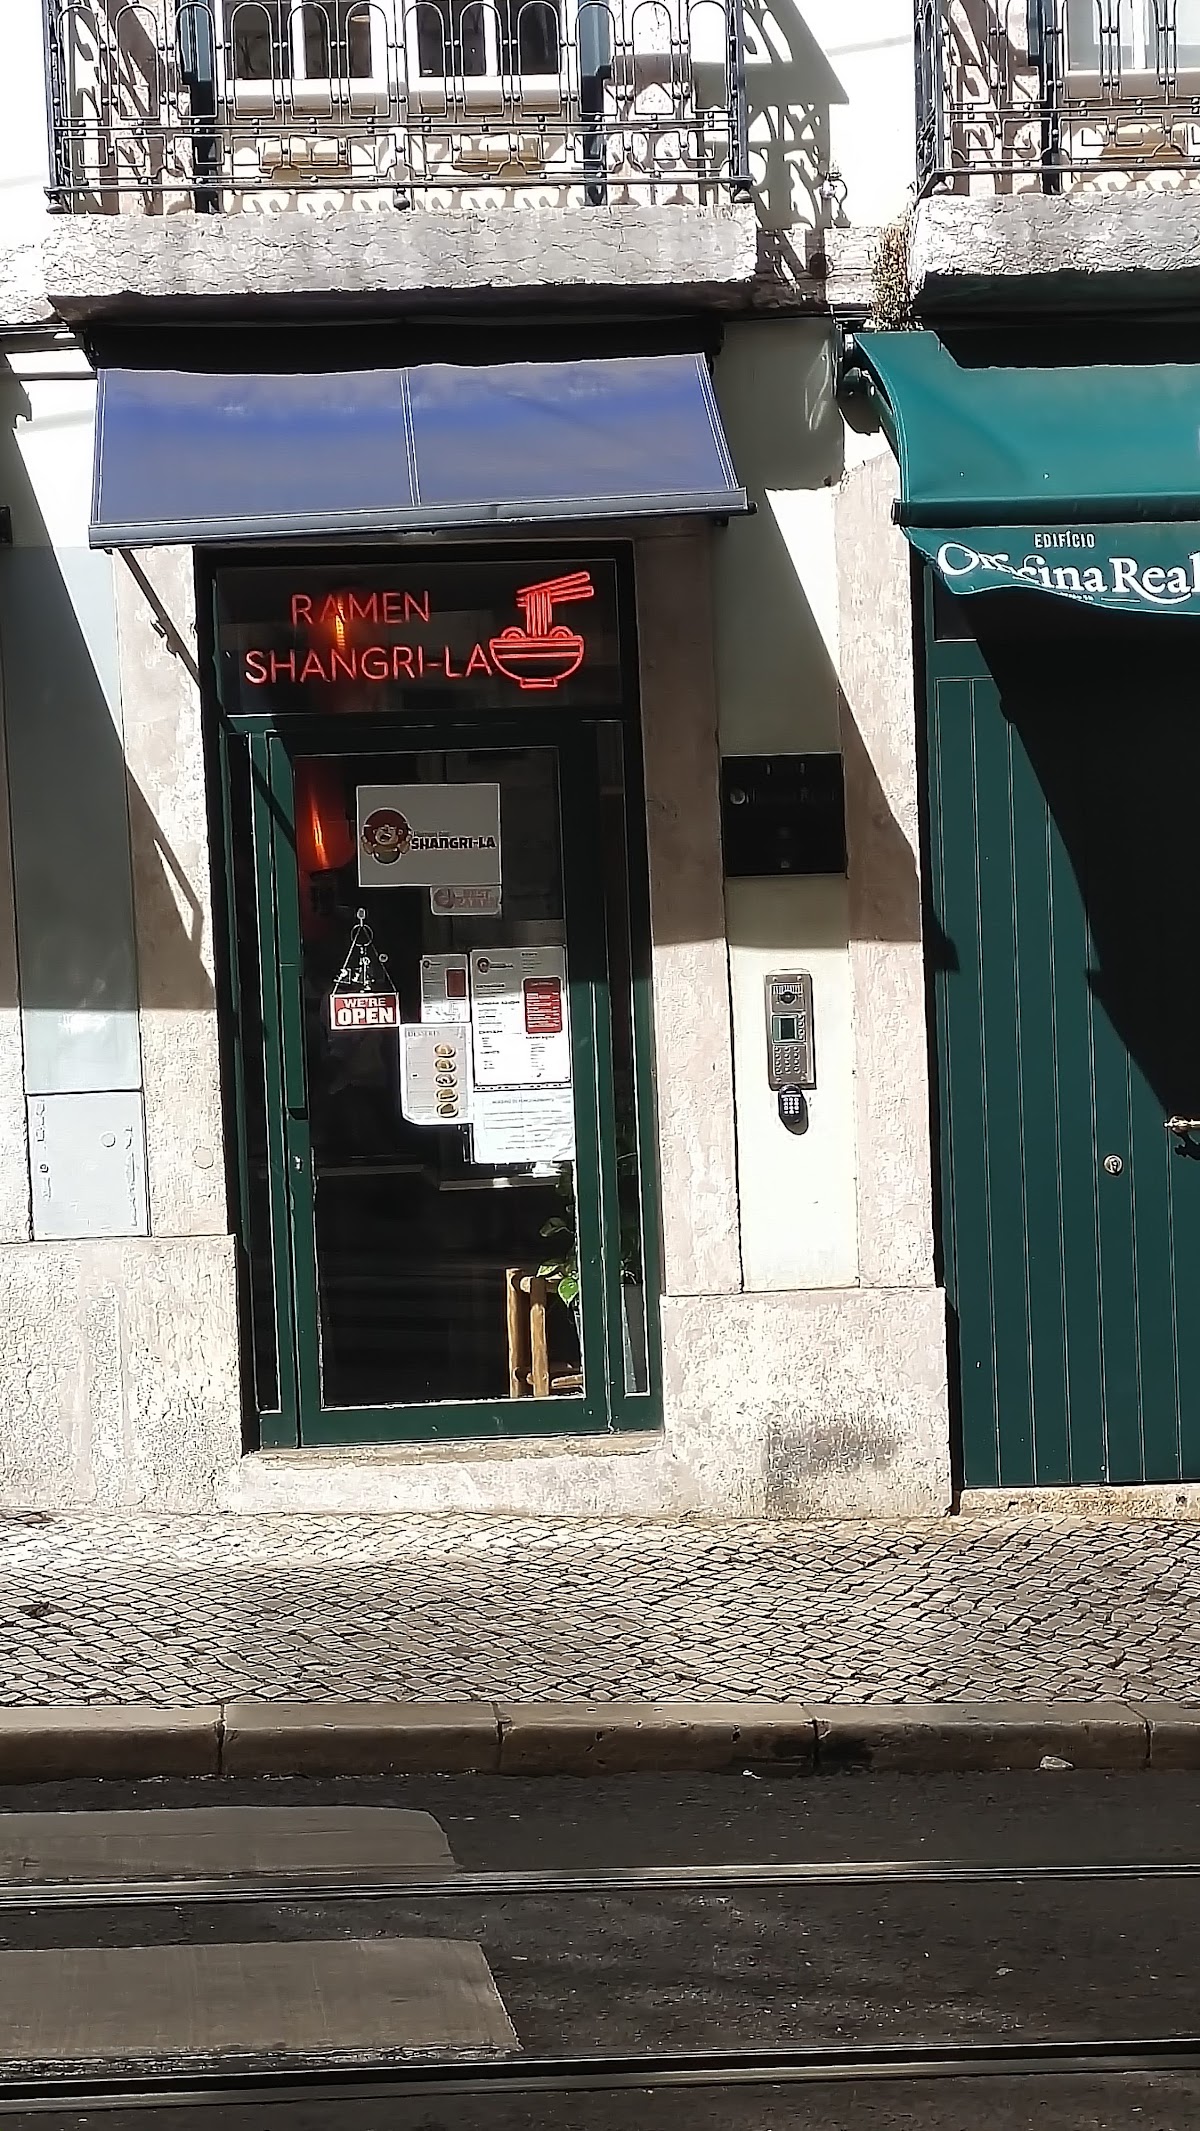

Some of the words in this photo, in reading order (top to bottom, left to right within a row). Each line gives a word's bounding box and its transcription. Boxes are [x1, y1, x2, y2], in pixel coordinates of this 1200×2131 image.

[1034, 530, 1096, 549] EDIFÍCIO
[1107, 552, 1200, 604] Real
[291, 590, 430, 625] RAMEN
[245, 644, 495, 684] SHANGRI-LA
[411, 835, 496, 850] SHANGRI-LA
[342, 997, 386, 1008] WE'RE
[337, 1006, 394, 1025] OPEN
